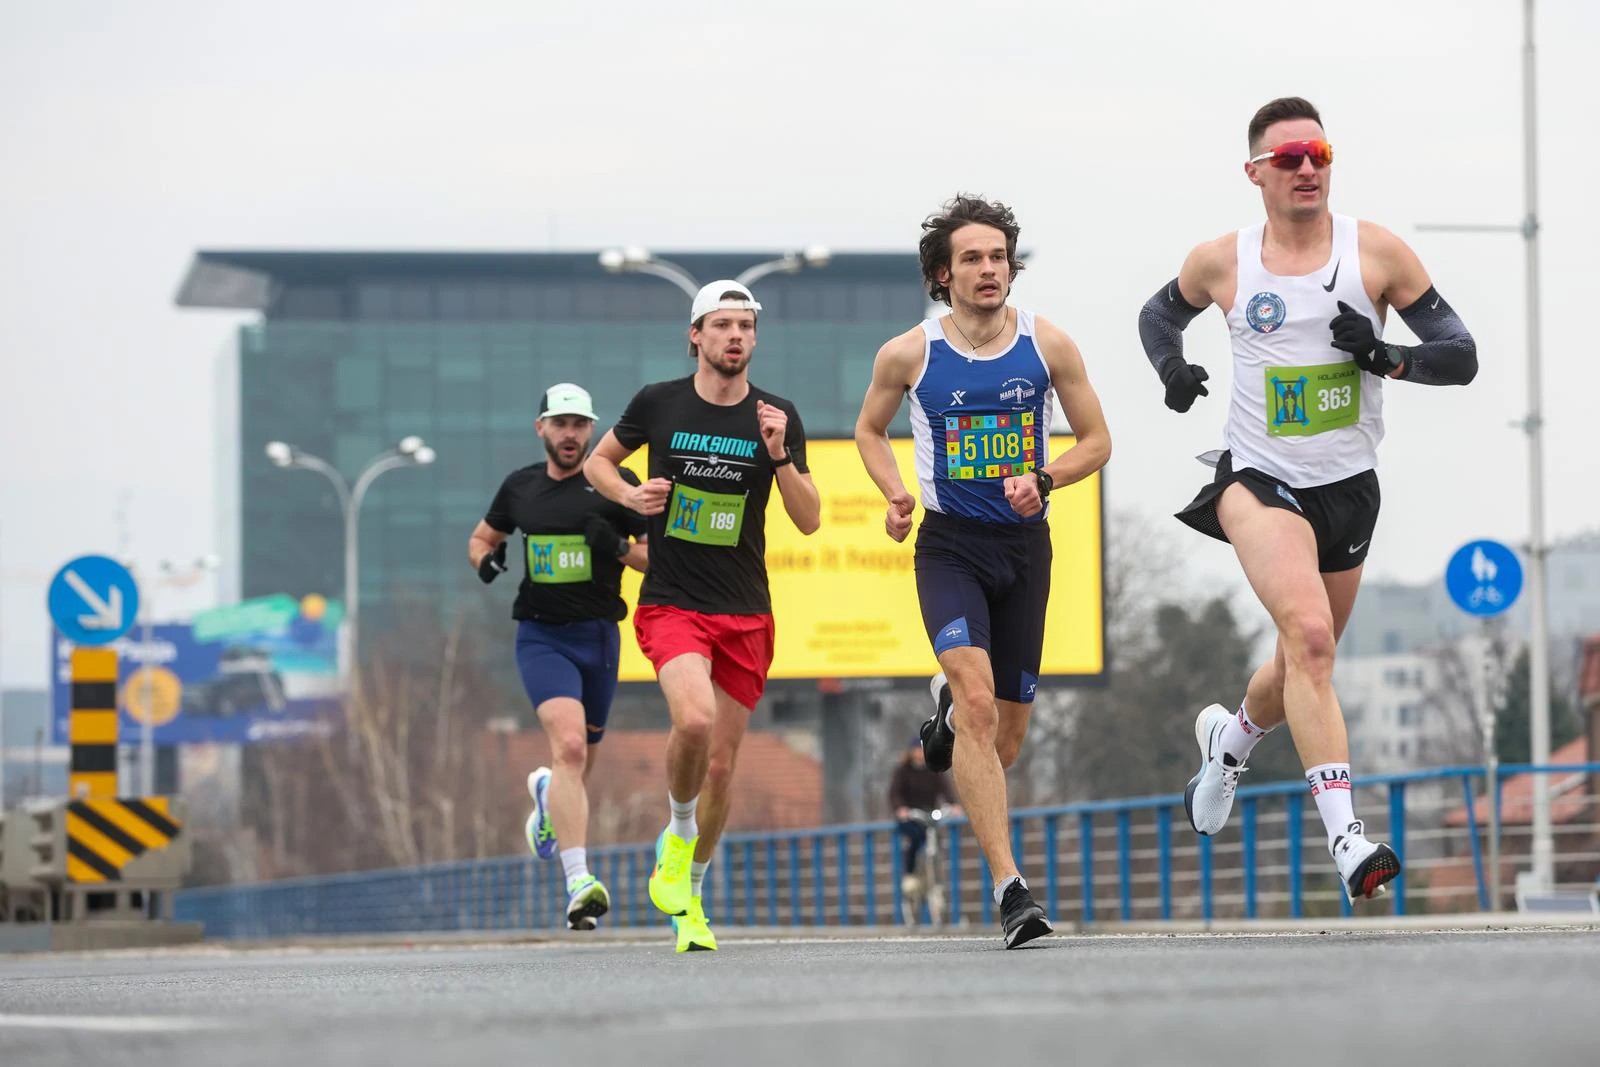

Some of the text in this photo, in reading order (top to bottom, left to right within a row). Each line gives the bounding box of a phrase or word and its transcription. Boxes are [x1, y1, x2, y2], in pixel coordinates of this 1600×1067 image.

[1317, 385, 1351, 412] 363
[670, 431, 758, 458] MAKSIMIR
[964, 433, 1020, 461] 5108
[683, 461, 742, 481] Triatlon
[710, 511, 736, 530] 189
[559, 551, 585, 569] 814
[766, 549, 815, 572] ake
